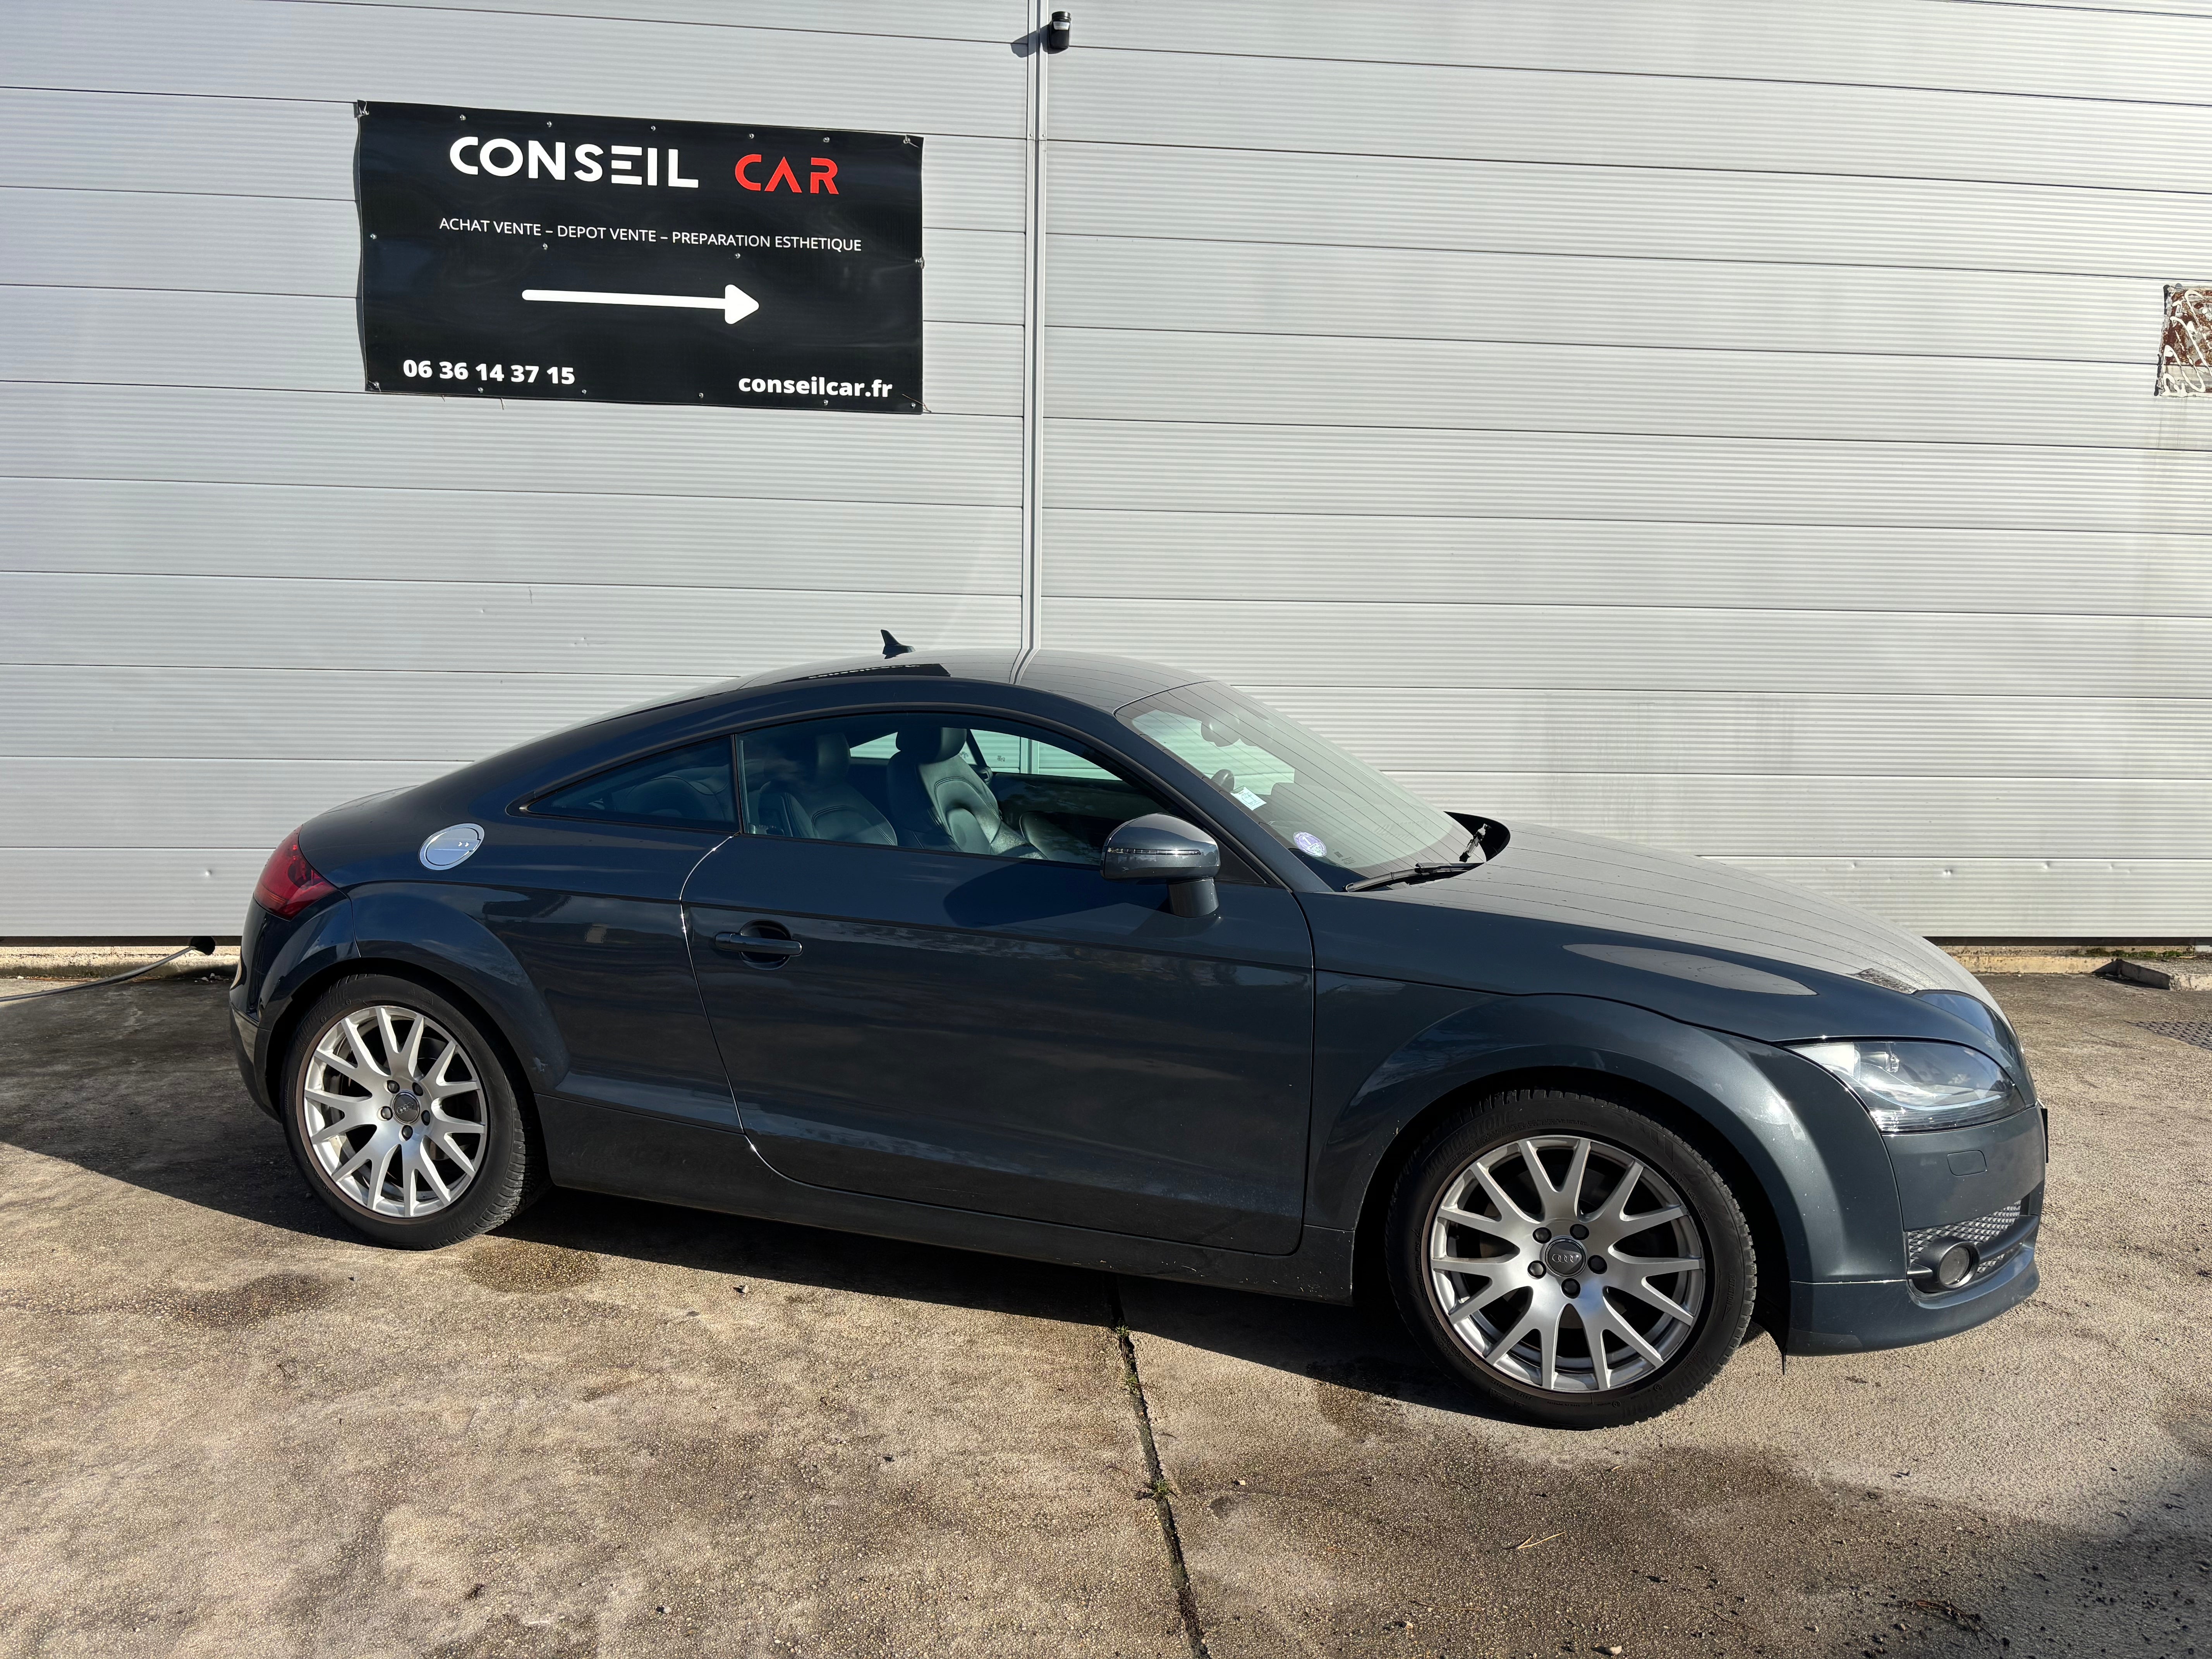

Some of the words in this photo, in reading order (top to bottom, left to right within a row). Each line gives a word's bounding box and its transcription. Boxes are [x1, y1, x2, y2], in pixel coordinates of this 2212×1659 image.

[449, 136, 699, 188] CONSEIL
[734, 153, 840, 194] CAR
[439, 218, 490, 232] ACHAT
[493, 221, 541, 236] VENTE
[557, 225, 606, 239] DEPOT
[609, 228, 656, 242] VENTE
[672, 232, 770, 247] PREPARATION
[775, 236, 862, 252] ESTHETIQUE
[403, 359, 433, 378] 06
[439, 361, 469, 380] 36
[475, 363, 505, 381] 14
[510, 365, 539, 383] 37
[546, 366, 575, 385] 15
[738, 376, 893, 397] conseilcar.fr
[1421, 1109, 1515, 1183] BRIDGESTONE
